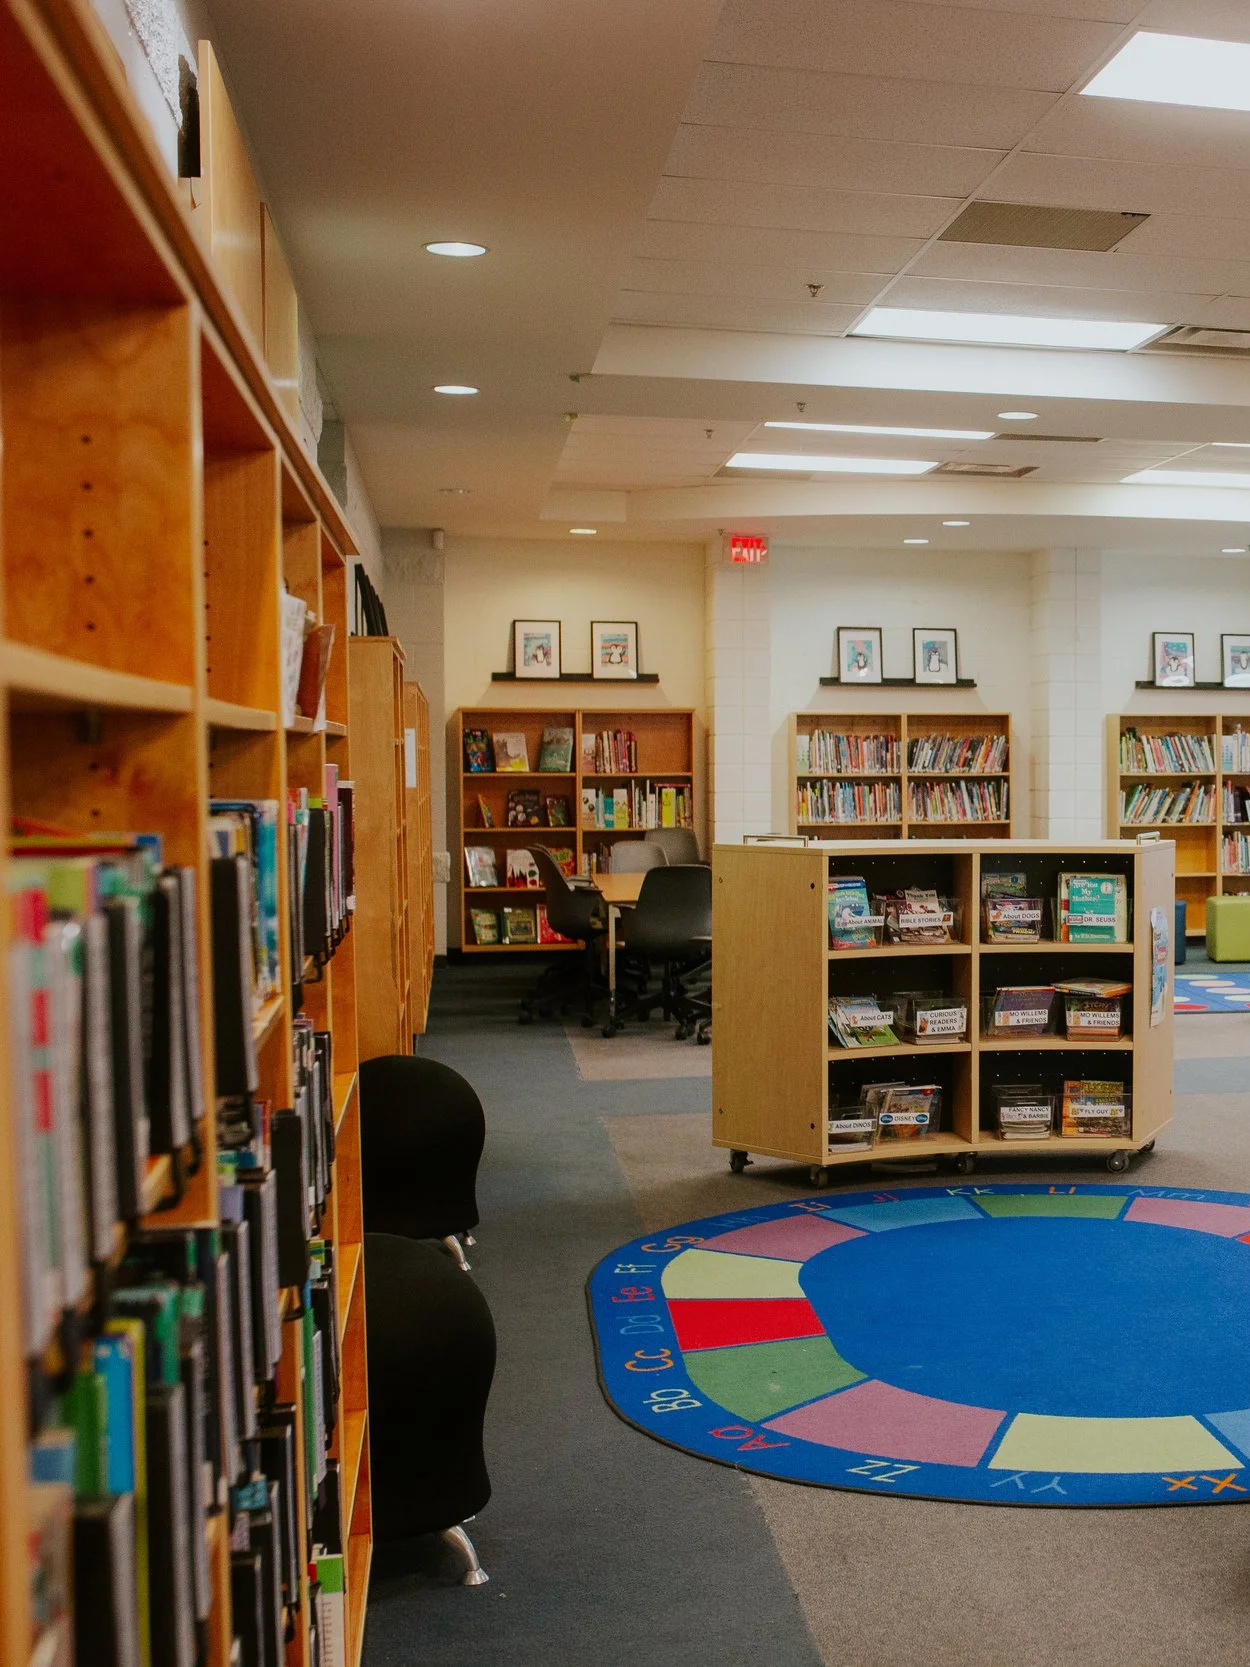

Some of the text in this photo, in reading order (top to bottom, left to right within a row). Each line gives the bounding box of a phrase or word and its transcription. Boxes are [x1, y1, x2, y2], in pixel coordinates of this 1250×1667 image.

[930, 1010, 957, 1018] CURIOUS
[611, 1286, 656, 1303] Ee
[619, 1314, 665, 1335] Dd
[624, 1348, 674, 1372] Cc
[643, 1388, 703, 1414] Bb
[708, 1424, 791, 1452] Aa
[846, 1459, 922, 1484] Zz
[1161, 1472, 1248, 1494] Xx
